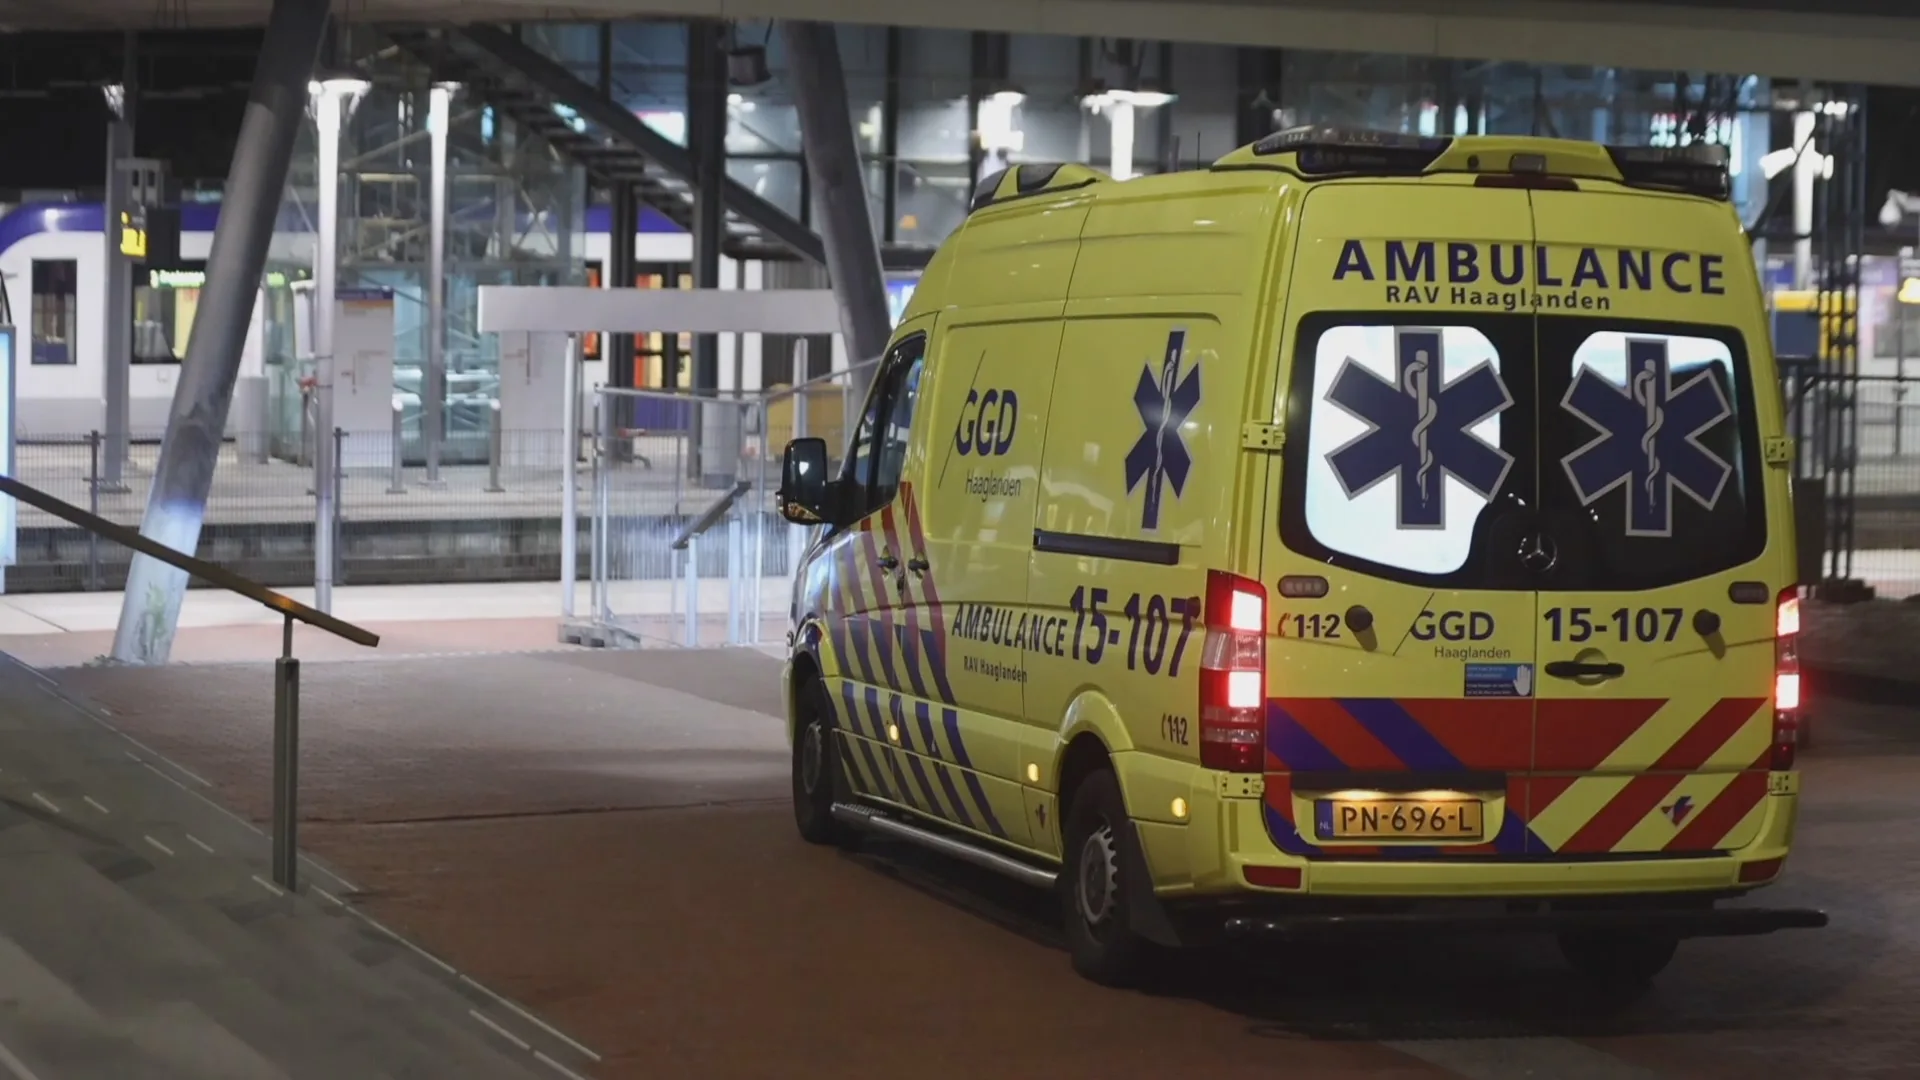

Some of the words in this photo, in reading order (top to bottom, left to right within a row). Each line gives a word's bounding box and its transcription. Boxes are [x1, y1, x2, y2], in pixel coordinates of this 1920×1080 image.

[1333, 239, 1725, 294] AMBULANCE
[1386, 286, 1440, 304] RAV
[1452, 287, 1610, 311] Haaglanden
[956, 388, 1018, 456] GGD
[965, 469, 1021, 503] Haaglanden
[952, 601, 1068, 657] AMBULANCE
[1069, 585, 1201, 677] 15-107
[1410, 611, 1495, 641] GGD
[1543, 607, 1683, 642] 15-107
[963, 655, 979, 673] RAV
[980, 660, 1027, 683] Haaglanden
[1434, 646, 1511, 661] Haaglanden
[1319, 821, 1331, 830] NL
[1340, 806, 1473, 832] PN-696-L
